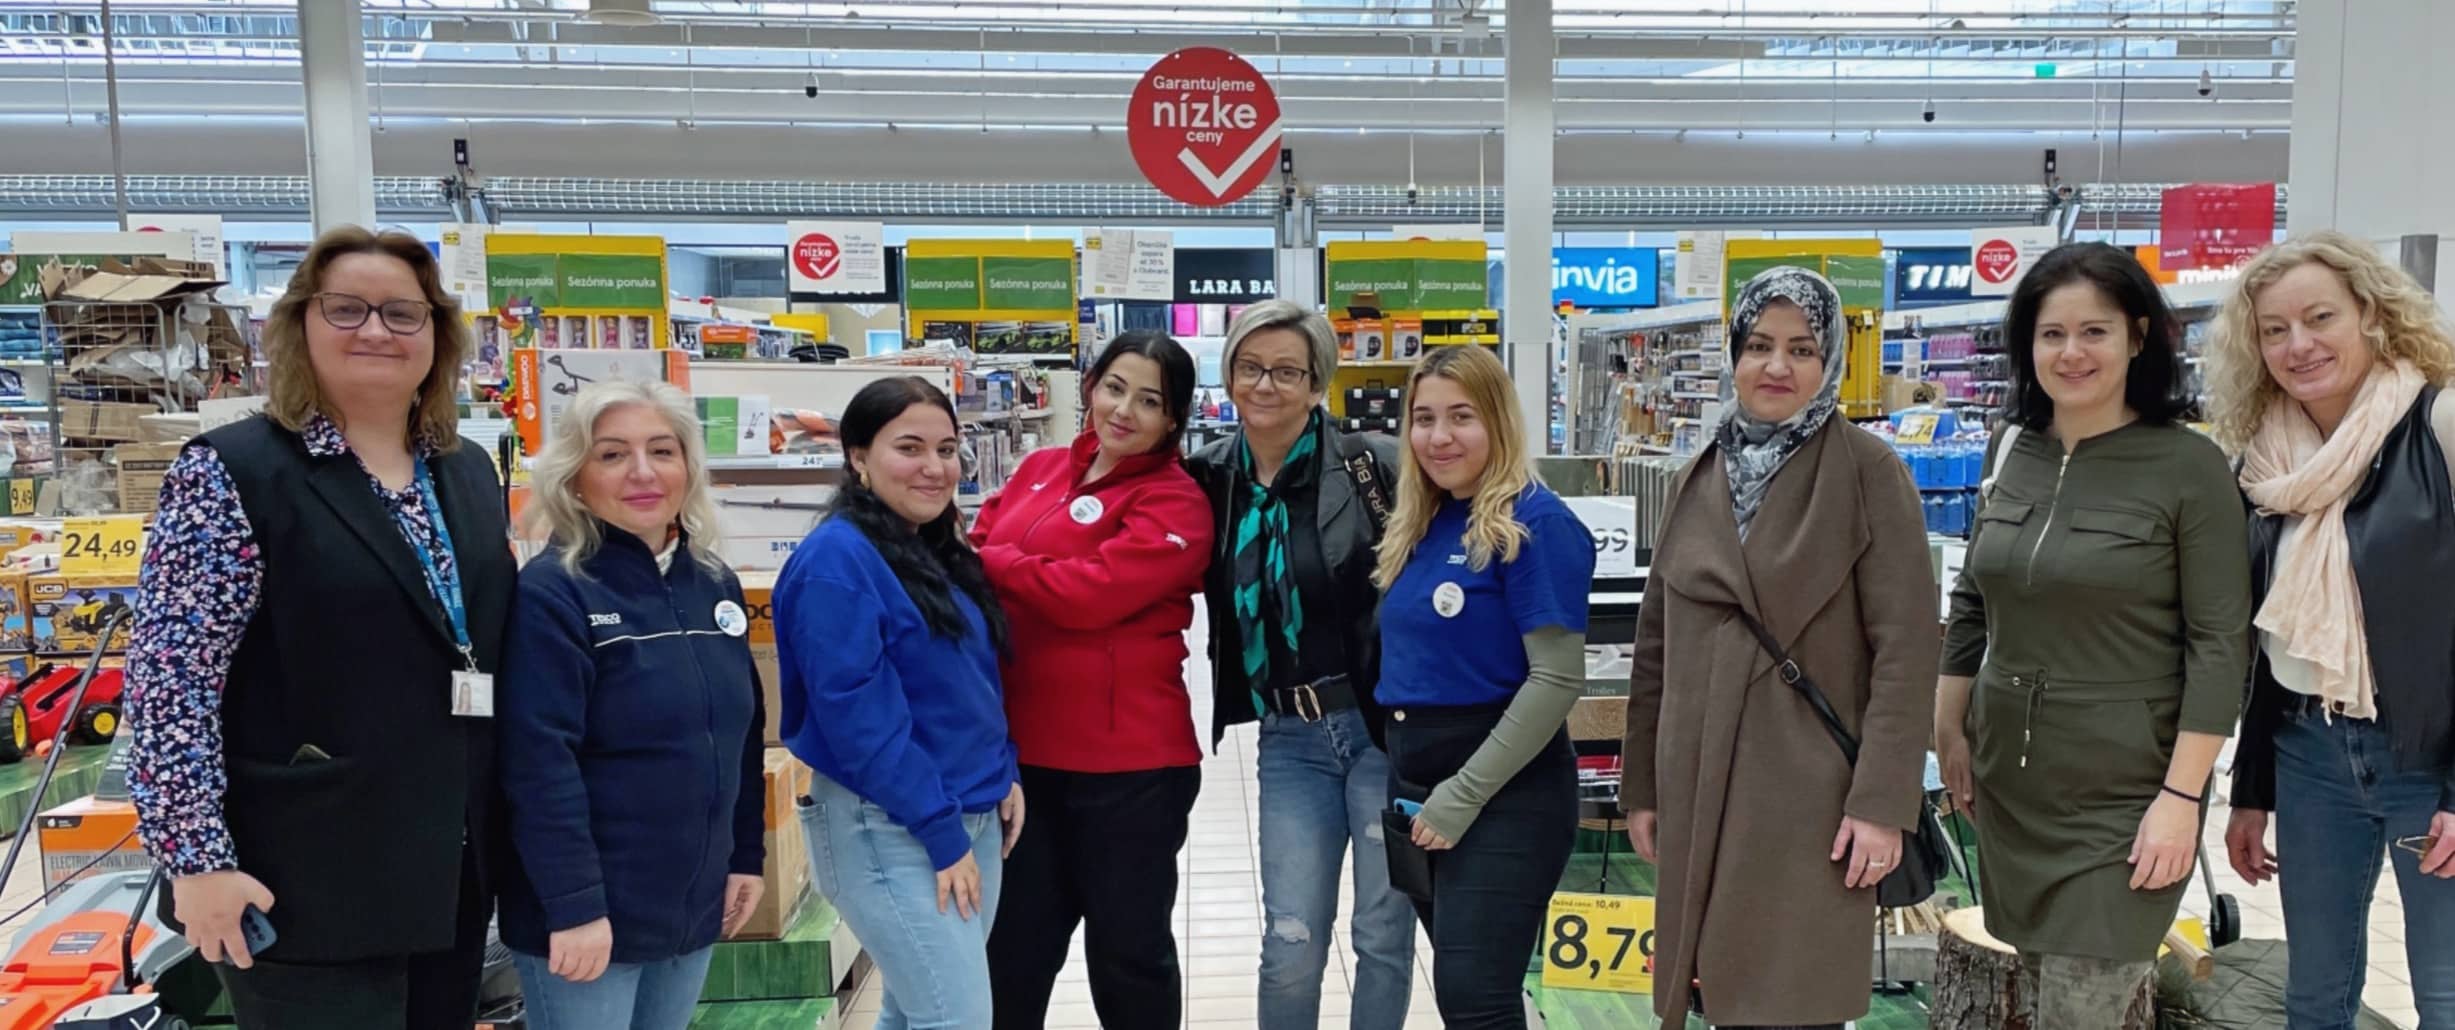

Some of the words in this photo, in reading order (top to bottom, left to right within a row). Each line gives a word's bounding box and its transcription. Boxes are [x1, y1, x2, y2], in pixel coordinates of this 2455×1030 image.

[1153, 75, 1256, 93] Garantujeme
[1153, 93, 1257, 129] nízke
[1186, 130, 1223, 146] ceny
[492, 276, 525, 287] Sezónna
[525, 276, 554, 288] ponuka
[567, 276, 614, 287] Sezónna
[616, 277, 656, 289] ponuka
[1552, 257, 1638, 294] invia
[1909, 265, 1972, 289] TIM
[911, 278, 943, 289] Sezónna
[944, 279, 974, 291] ponuka
[990, 278, 1030, 289] Sezónna
[1032, 278, 1067, 291] ponuka
[1189, 279, 1243, 295] LARA
[1334, 280, 1372, 291] Sezónna
[1374, 281, 1408, 292] ponuka
[1418, 280, 1451, 291] Sezónna
[1452, 281, 1483, 291] ponuka
[11, 488, 33, 509] 9,49
[63, 532, 137, 562] 24,49
[35, 584, 64, 595] JCB
[50, 854, 93, 872] ELECTRIC
[1595, 900, 1621, 910] 10,49
